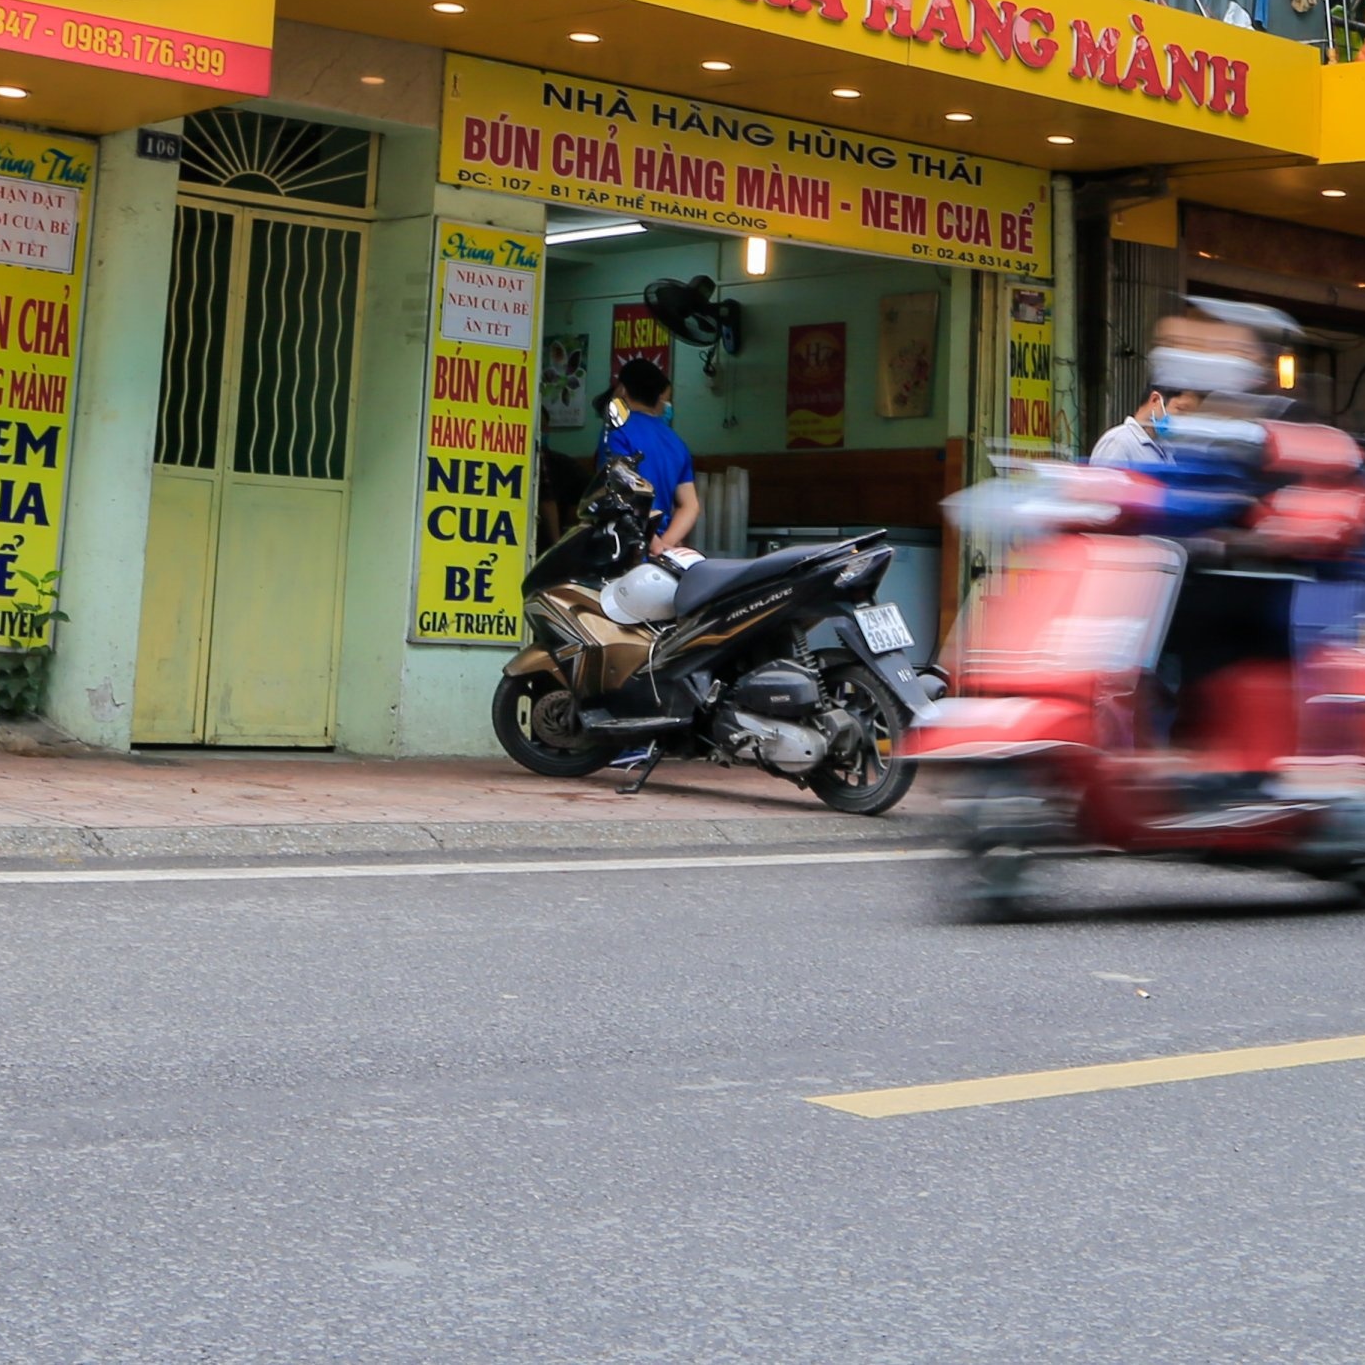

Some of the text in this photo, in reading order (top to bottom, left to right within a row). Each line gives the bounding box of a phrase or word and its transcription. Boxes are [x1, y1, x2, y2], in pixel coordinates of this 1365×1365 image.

[61, 20, 225, 78] 0983.176.399
[1071, 12, 1251, 119] MÀNH
[145, 136, 177, 158] 106
[541, 81, 985, 189] NHÀ HÀNG HÙNG THÁI
[31, 190, 66, 211] ĐẠT
[456, 168, 768, 231] ĐC: 107 B1 TẬP THỂ THÀNH CÔNG
[462, 109, 541, 173] BÚN
[550, 123, 624, 187] CHẢ
[633, 143, 726, 205] HÀNG
[735, 161, 832, 223] MÀNH
[860, 187, 929, 239] NEM
[935, 199, 993, 248] CUA
[998, 201, 1037, 256] BỂ
[11, 215, 45, 232] CUA
[910, 241, 935, 258] ĐT:
[976, 252, 1013, 271] 8314
[1015, 259, 1041, 277] 347
[455, 268, 526, 294] NHẬN ĐẠT
[17, 285, 72, 358] CHẢ
[447, 291, 512, 316] NEM CUA
[462, 315, 484, 334] ĂN
[8, 358, 67, 415] MÀNH
[434, 350, 530, 410] BÚN CHẢ
[430, 414, 527, 456] HÀNG MÀNH
[426, 455, 524, 500] NEM
[426, 504, 519, 546] CUA
[444, 552, 499, 604] BỂ
[418, 610, 518, 637] GIA TRUYỀN
